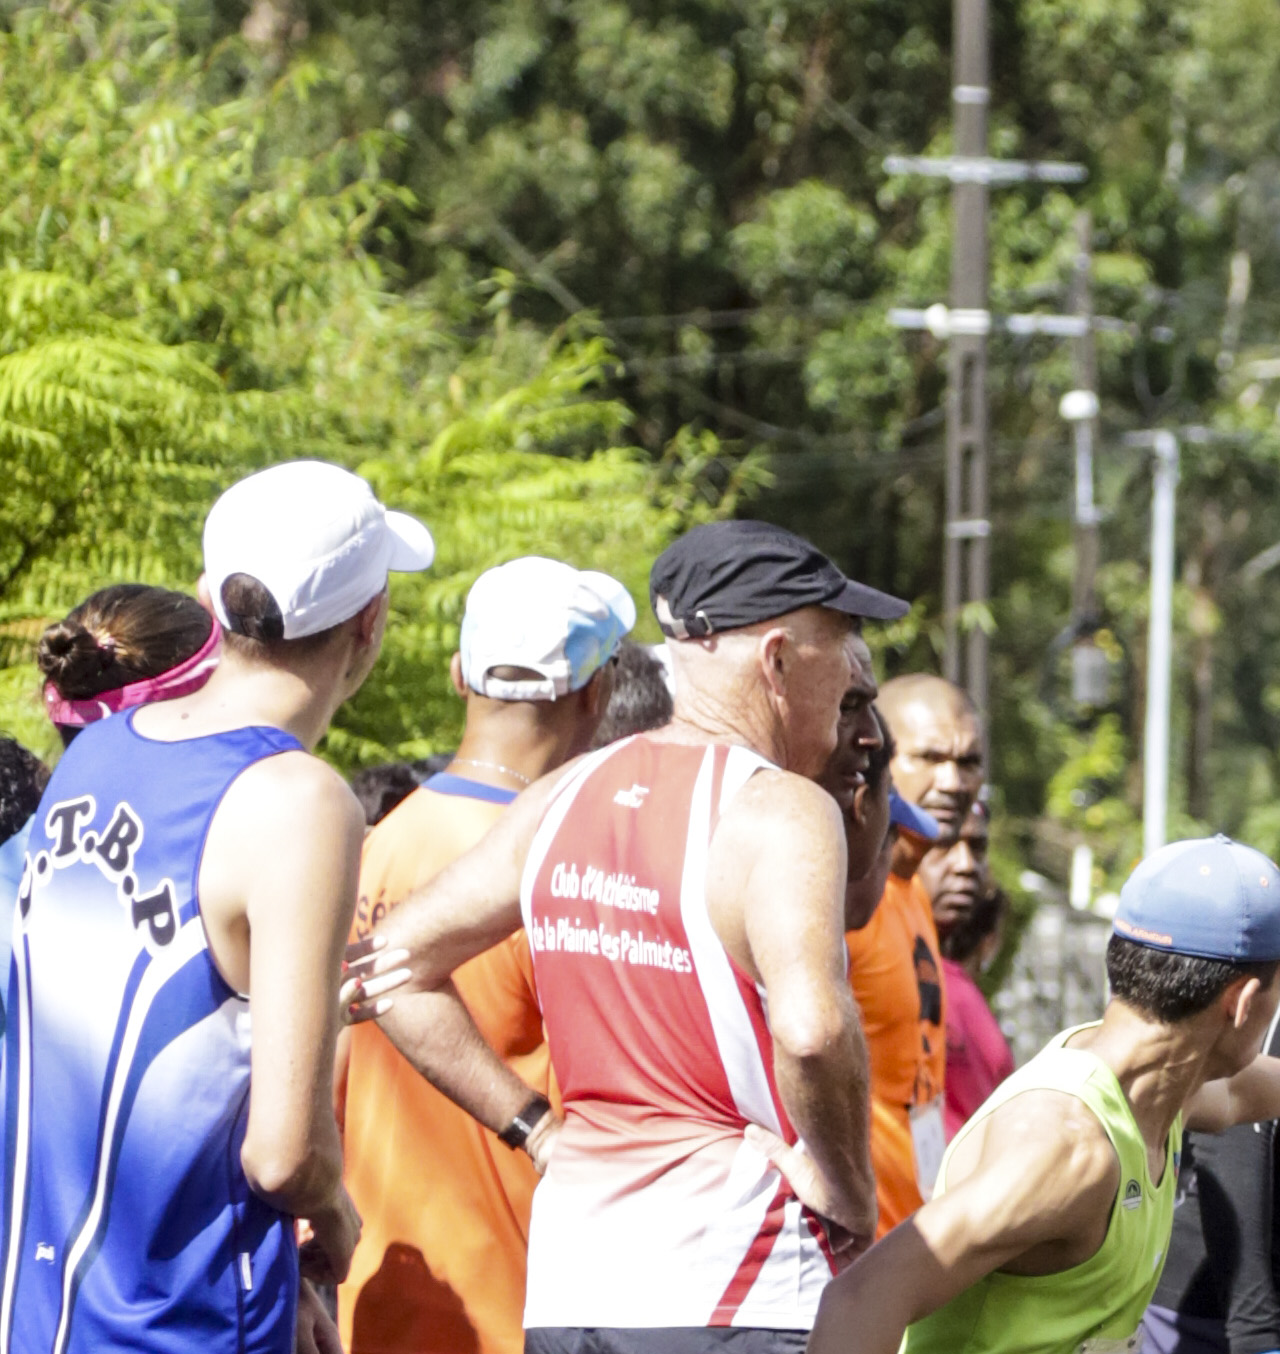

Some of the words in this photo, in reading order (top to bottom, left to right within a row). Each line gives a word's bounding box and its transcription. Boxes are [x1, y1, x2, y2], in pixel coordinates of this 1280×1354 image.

[550, 862, 580, 899] Club
[544, 915, 556, 951] la
[556, 917, 599, 955] Plaine
[620, 929, 693, 973] Palmistes
